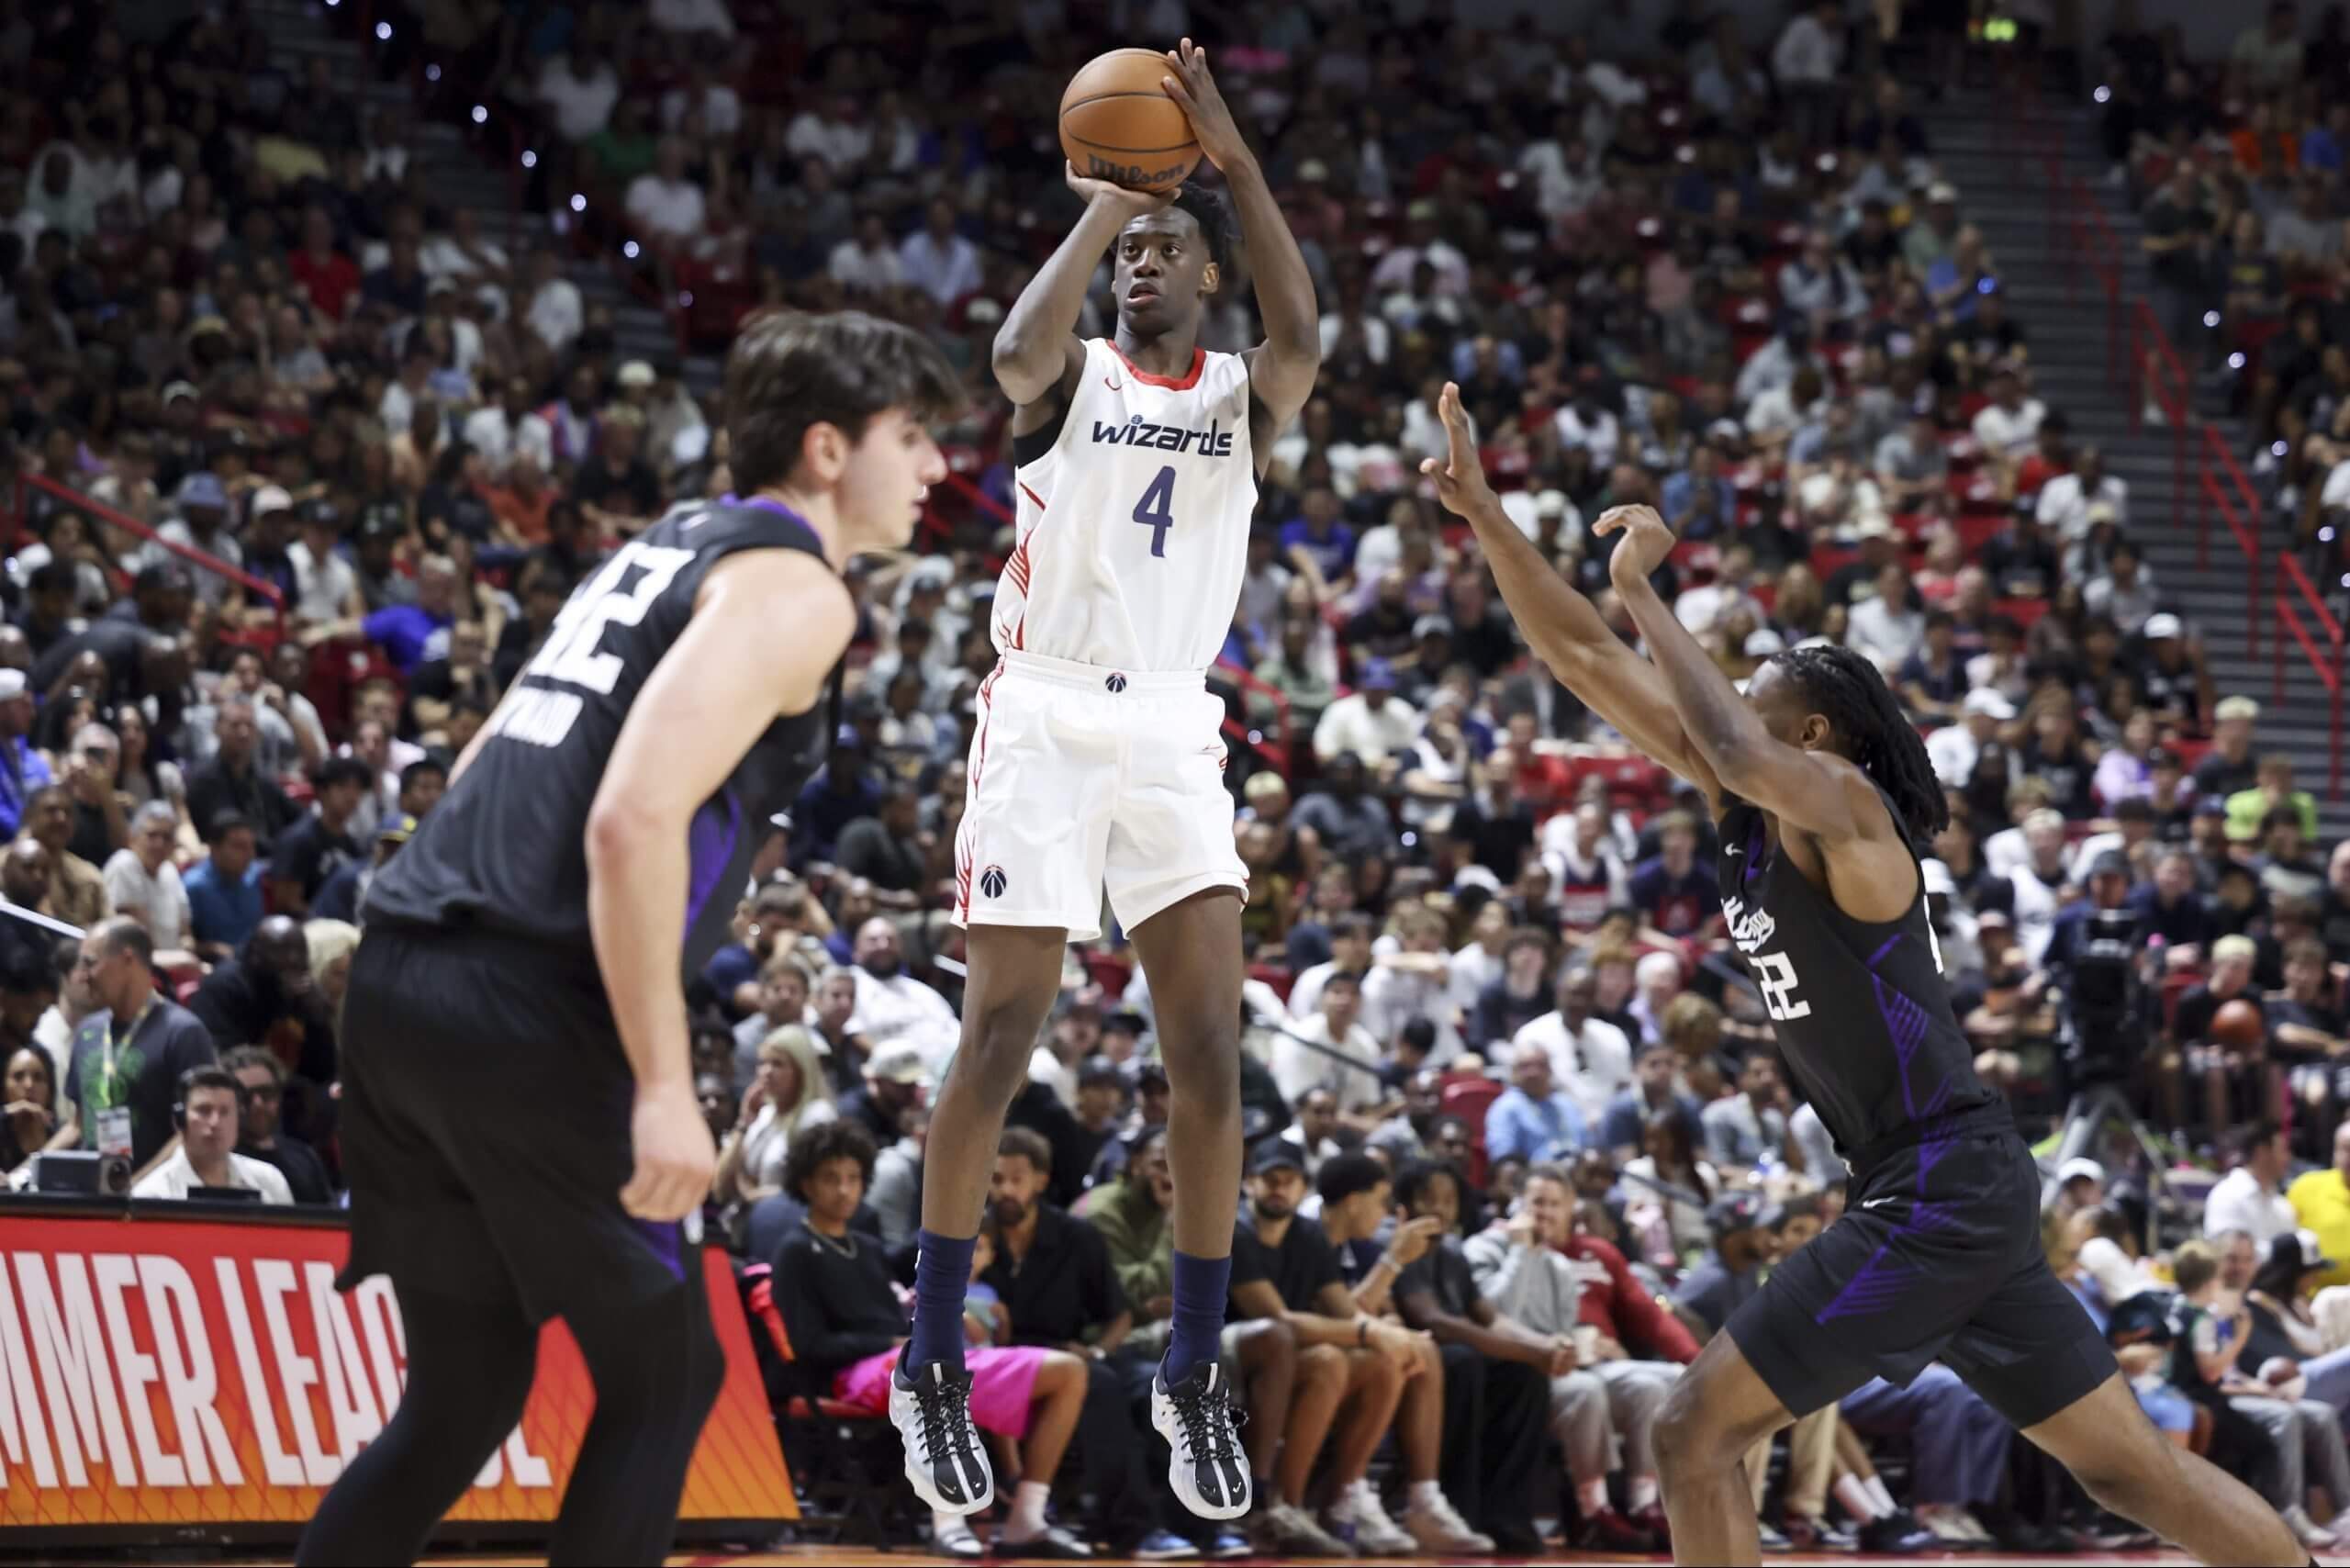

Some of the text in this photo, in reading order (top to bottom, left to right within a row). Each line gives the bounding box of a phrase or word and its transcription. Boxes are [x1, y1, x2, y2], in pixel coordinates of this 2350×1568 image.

[1087, 152, 1184, 186] Wilson
[1092, 414, 1233, 456] wizards
[1132, 465, 1176, 558] 4
[1748, 950, 1811, 1021] 22
